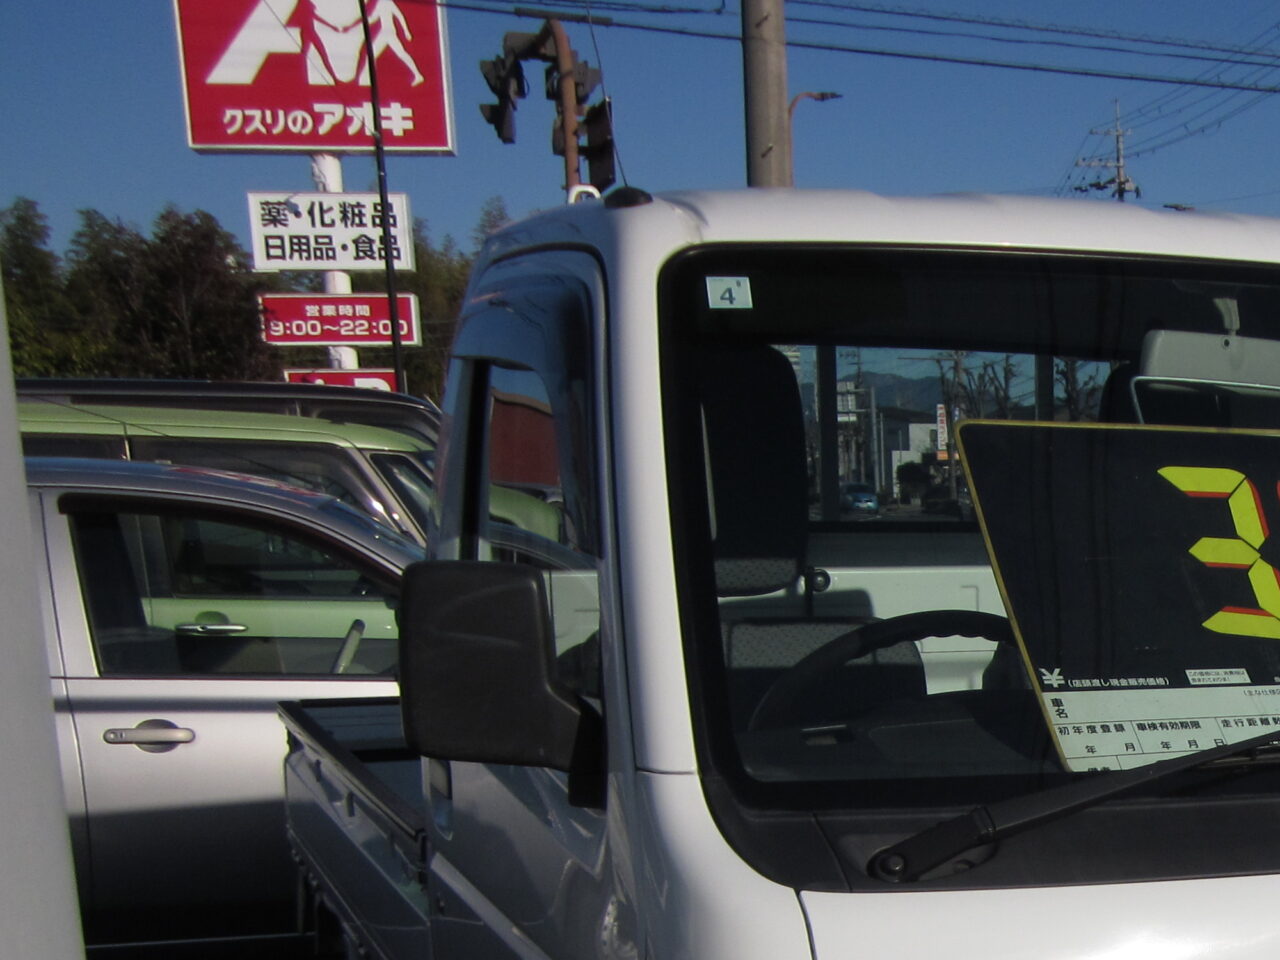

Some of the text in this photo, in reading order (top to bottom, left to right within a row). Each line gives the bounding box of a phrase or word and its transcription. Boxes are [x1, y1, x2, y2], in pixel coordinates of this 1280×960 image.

[222, 101, 415, 137] クスリのアオキ
[259, 200, 398, 229] 薬・化粧品
[263, 234, 402, 262] 日用品・食品
[720, 287, 736, 305] 4
[305, 304, 371, 317] 営業時間
[1057, 724, 1126, 736] 初年度登録
[1136, 720, 1202, 732] 車検有効期限
[1084, 742, 1137, 755] 年 月
[1160, 740, 1173, 750] 年
[1188, 739, 1199, 749] 月
